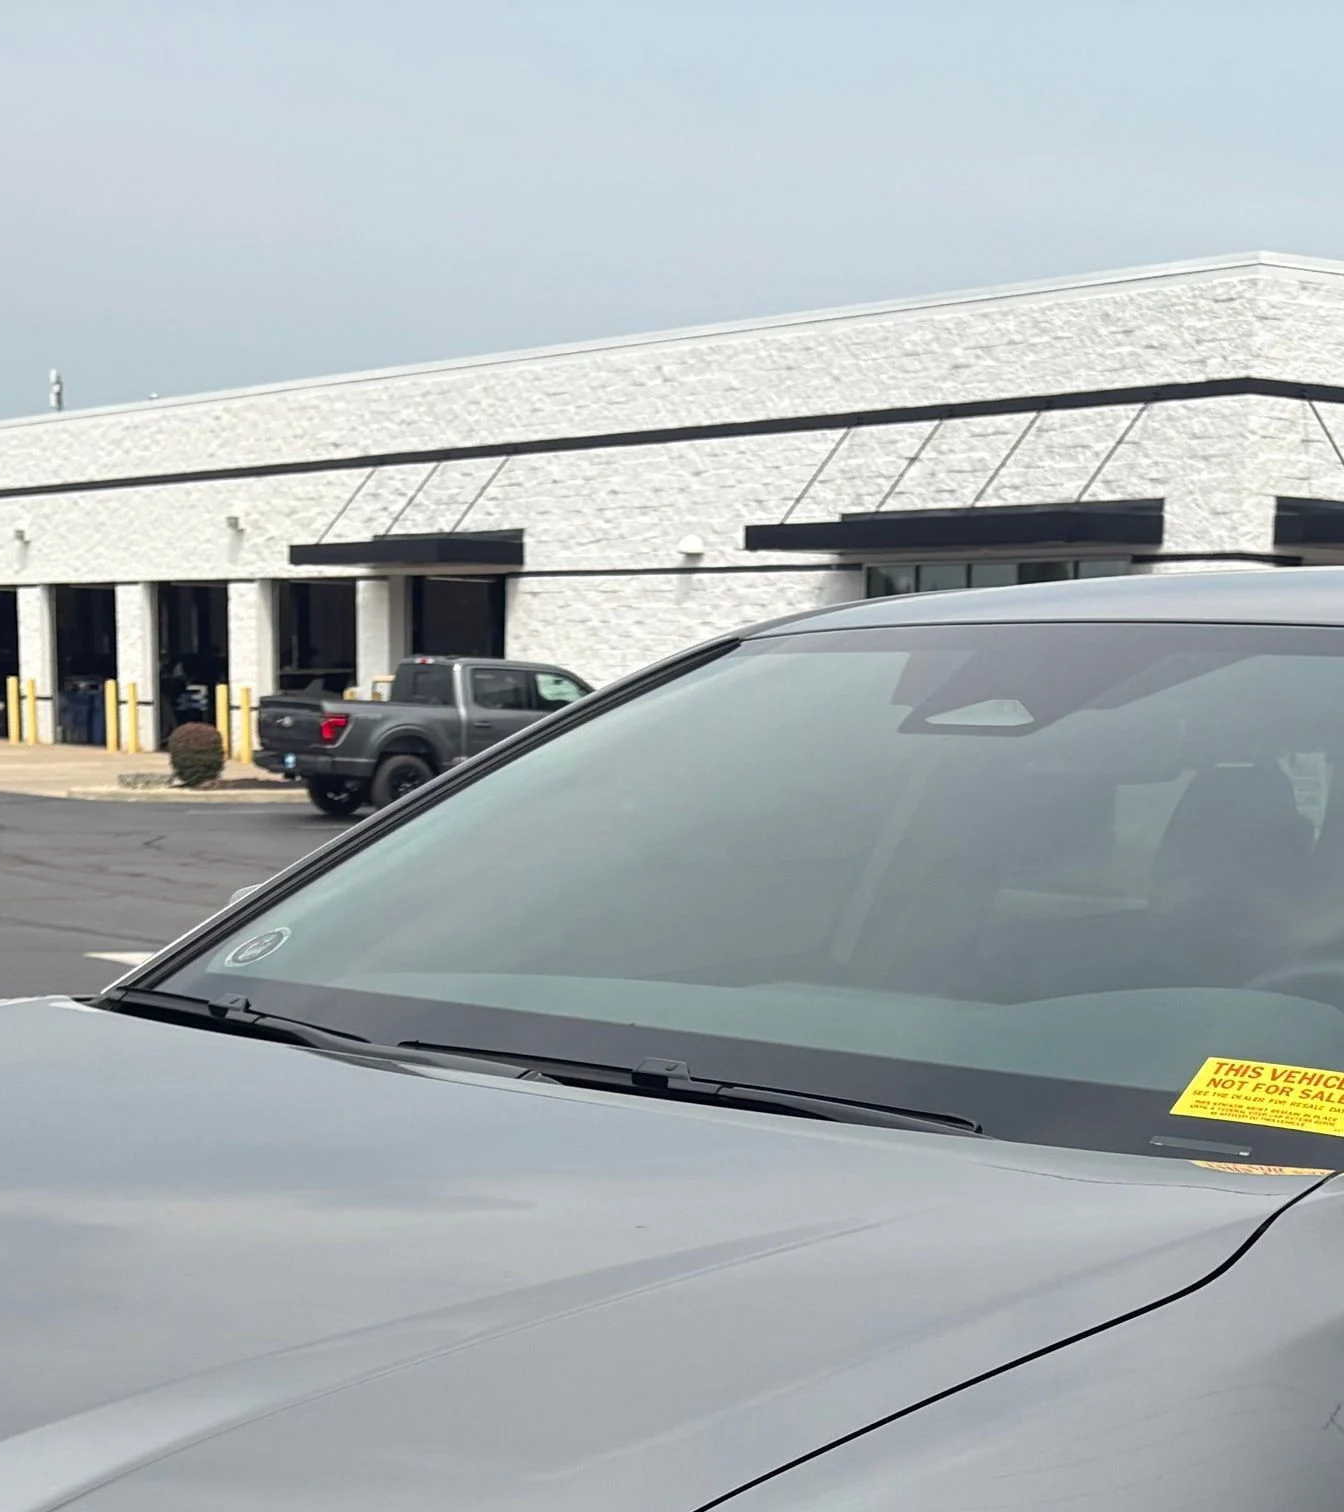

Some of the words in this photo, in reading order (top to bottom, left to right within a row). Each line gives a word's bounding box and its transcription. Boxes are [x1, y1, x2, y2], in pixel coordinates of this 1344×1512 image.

[1213, 1062, 1264, 1080] THIS
[1206, 1077, 1249, 1092] NOT
[1252, 1083, 1294, 1097] FOR
[1231, 1093, 1265, 1103] DEALER
[1289, 1101, 1325, 1111] RESALE
